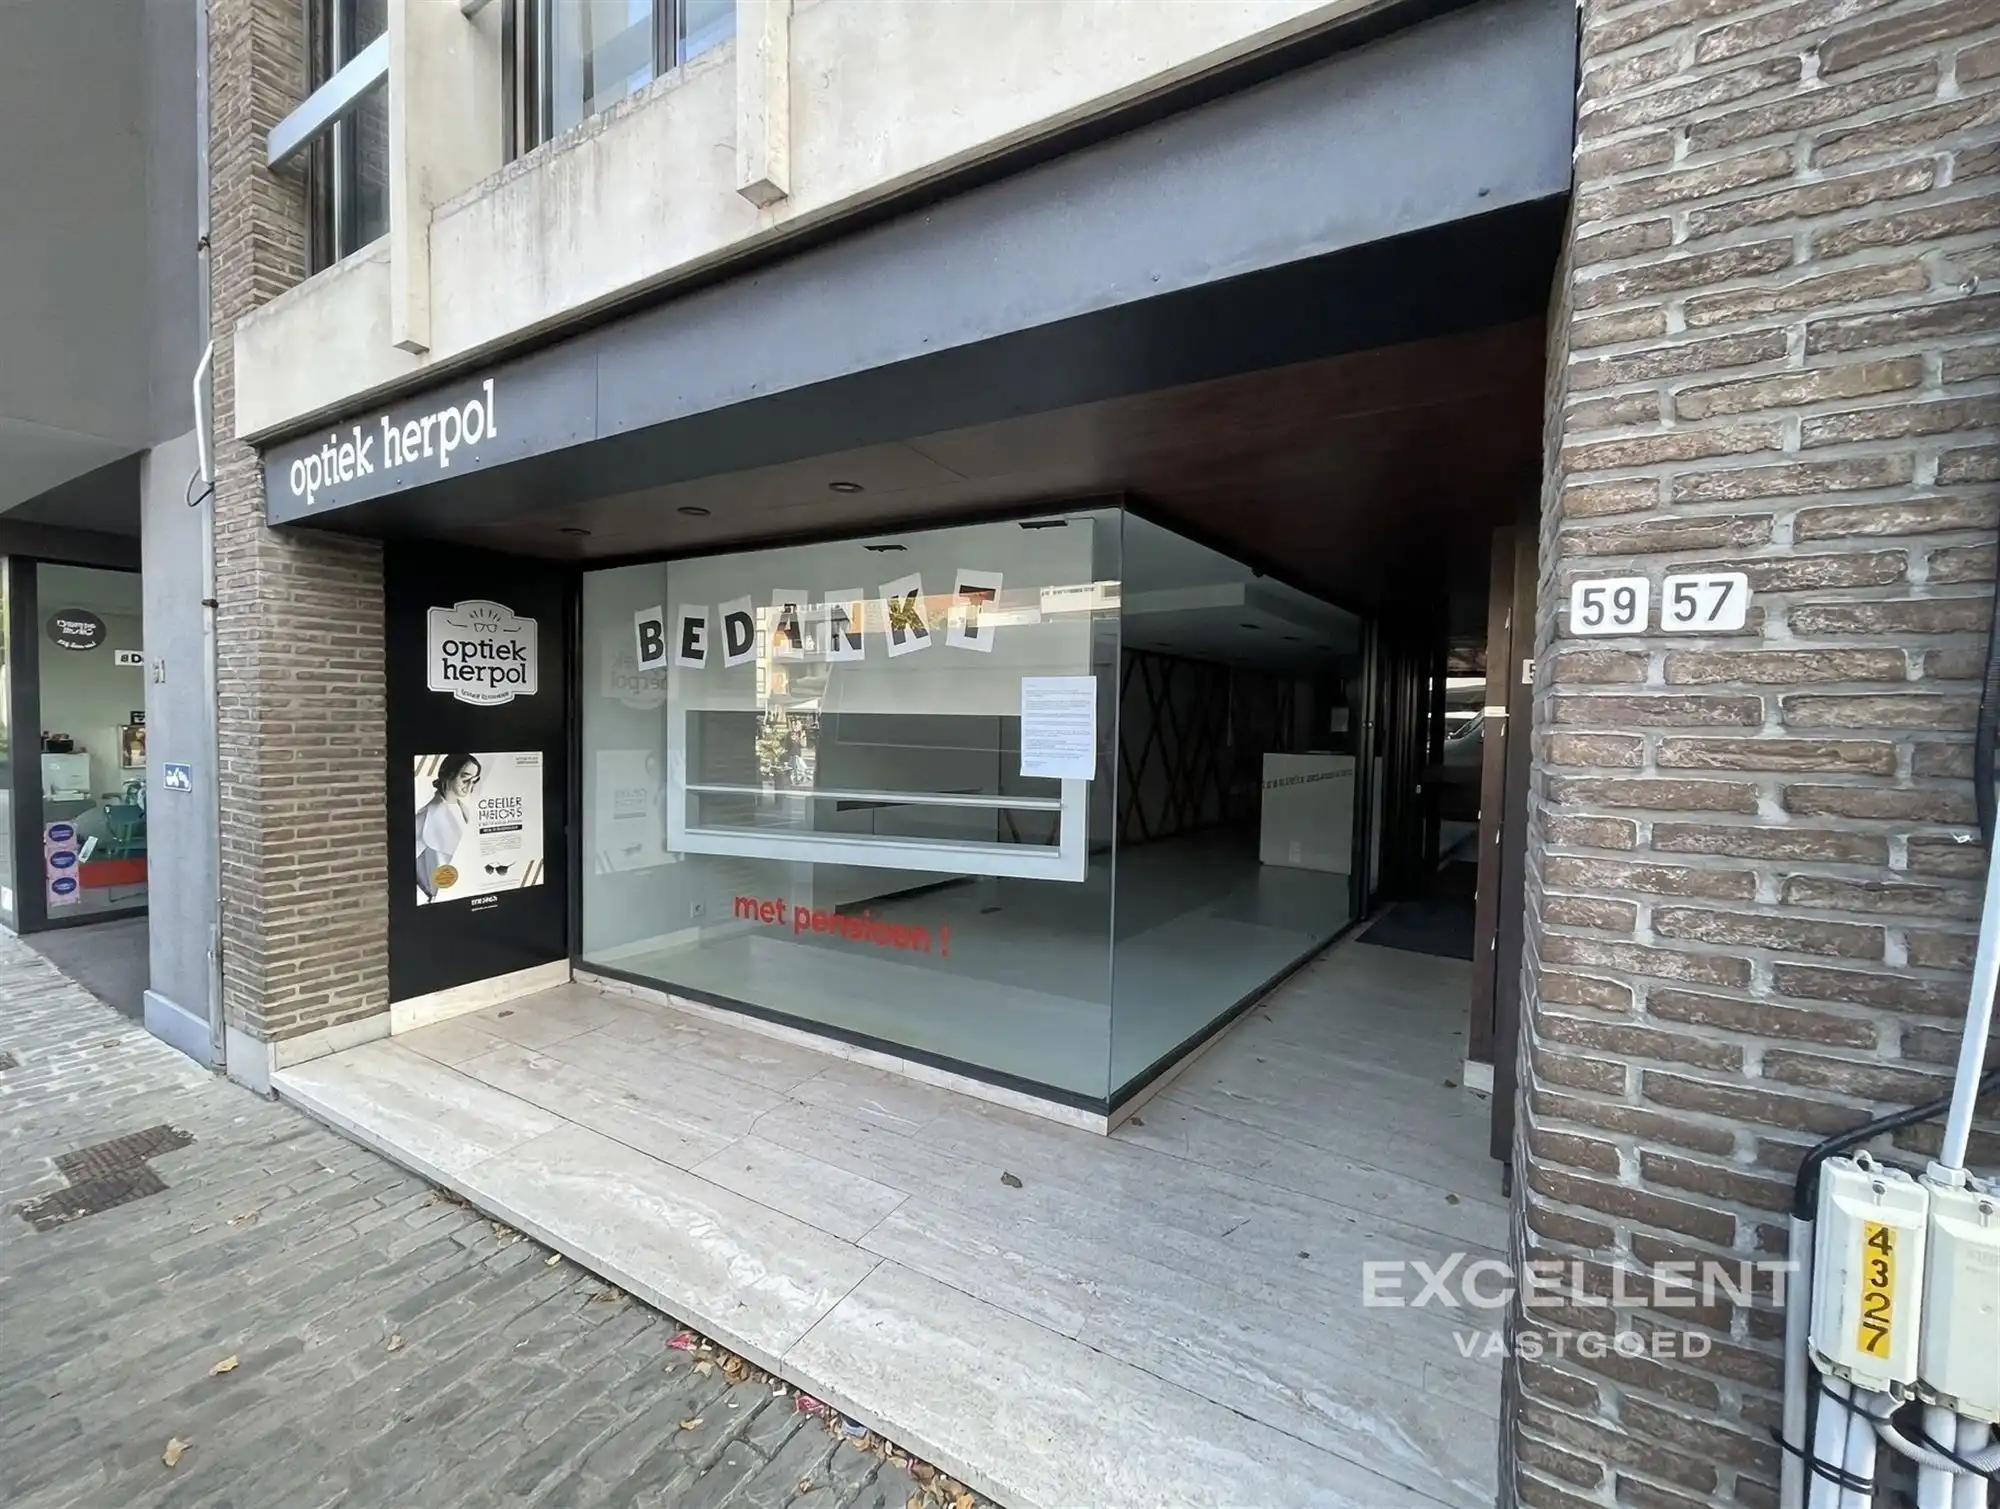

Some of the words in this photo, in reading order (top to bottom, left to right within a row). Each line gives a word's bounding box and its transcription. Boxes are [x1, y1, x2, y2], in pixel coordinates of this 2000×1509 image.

[290, 425, 374, 505] optiek
[380, 378, 497, 468] herpol
[638, 584, 996, 663] BEDANKT
[1582, 586, 1637, 626] 59
[1673, 581, 1735, 622] 57
[442, 638, 527, 663] optiek
[442, 658, 527, 688] herpol
[734, 895, 787, 925] met
[794, 908, 931, 955] pensioen
[938, 922, 949, 960] !
[1863, 1226, 1893, 1353] 4327
